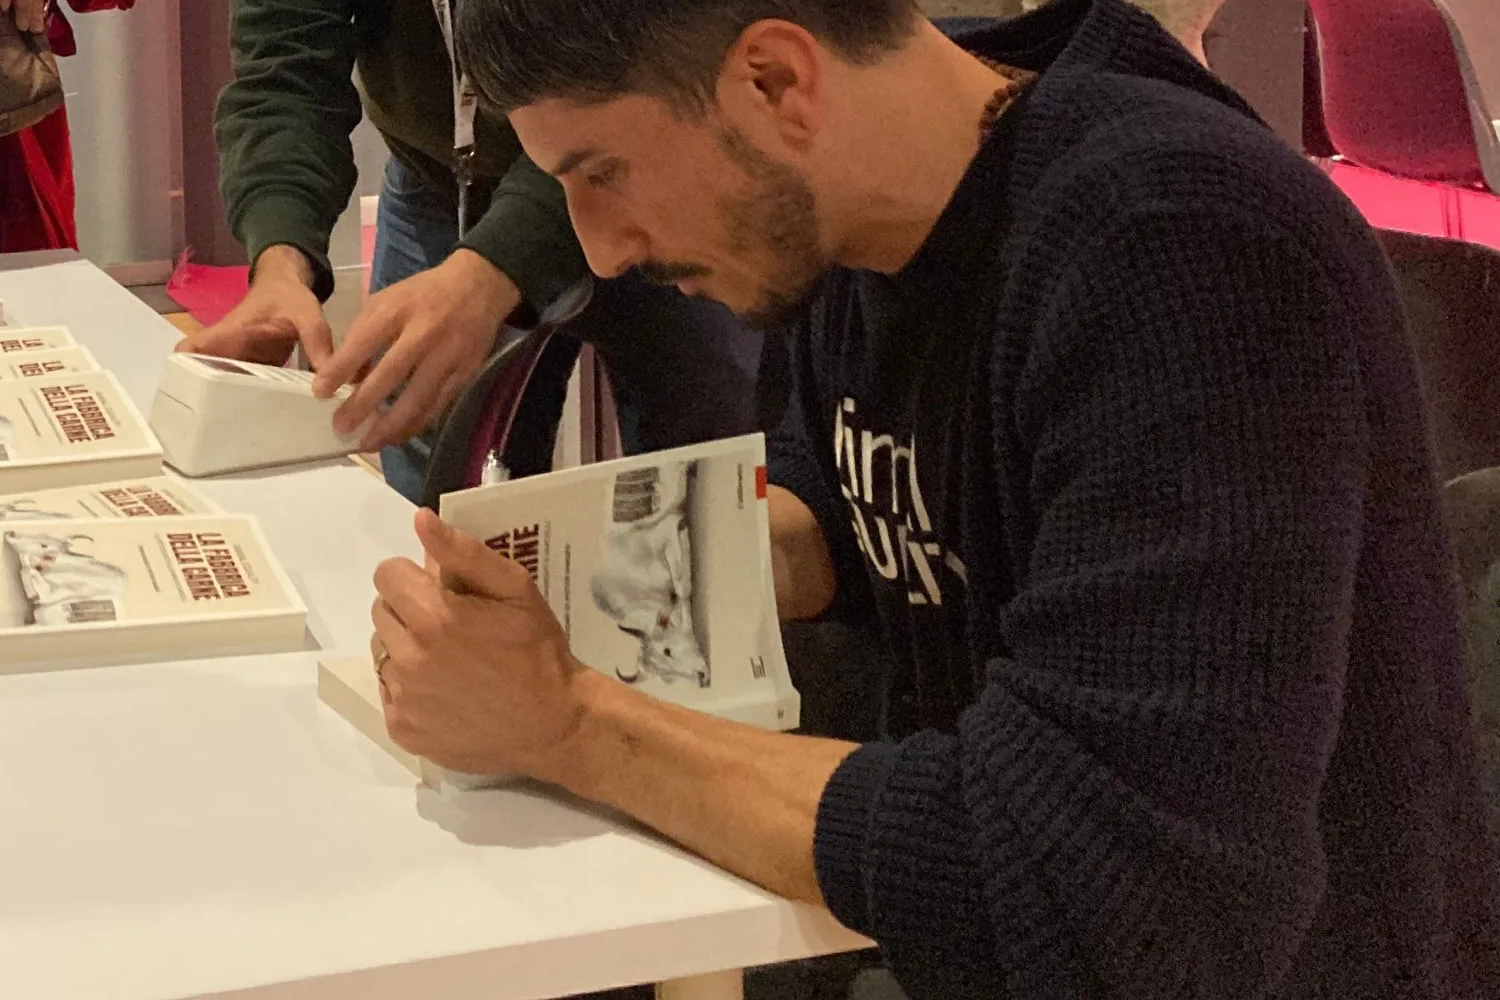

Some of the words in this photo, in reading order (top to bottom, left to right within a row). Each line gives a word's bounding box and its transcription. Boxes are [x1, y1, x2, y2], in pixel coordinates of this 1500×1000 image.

[40, 386, 73, 412] DELLA
[64, 384, 89, 395] LA
[56, 413, 92, 444] CARNE
[167, 533, 204, 563] DELLA
[196, 532, 225, 545] LA
[181, 567, 222, 601] CARNE
[202, 548, 251, 598] FABBRICA
